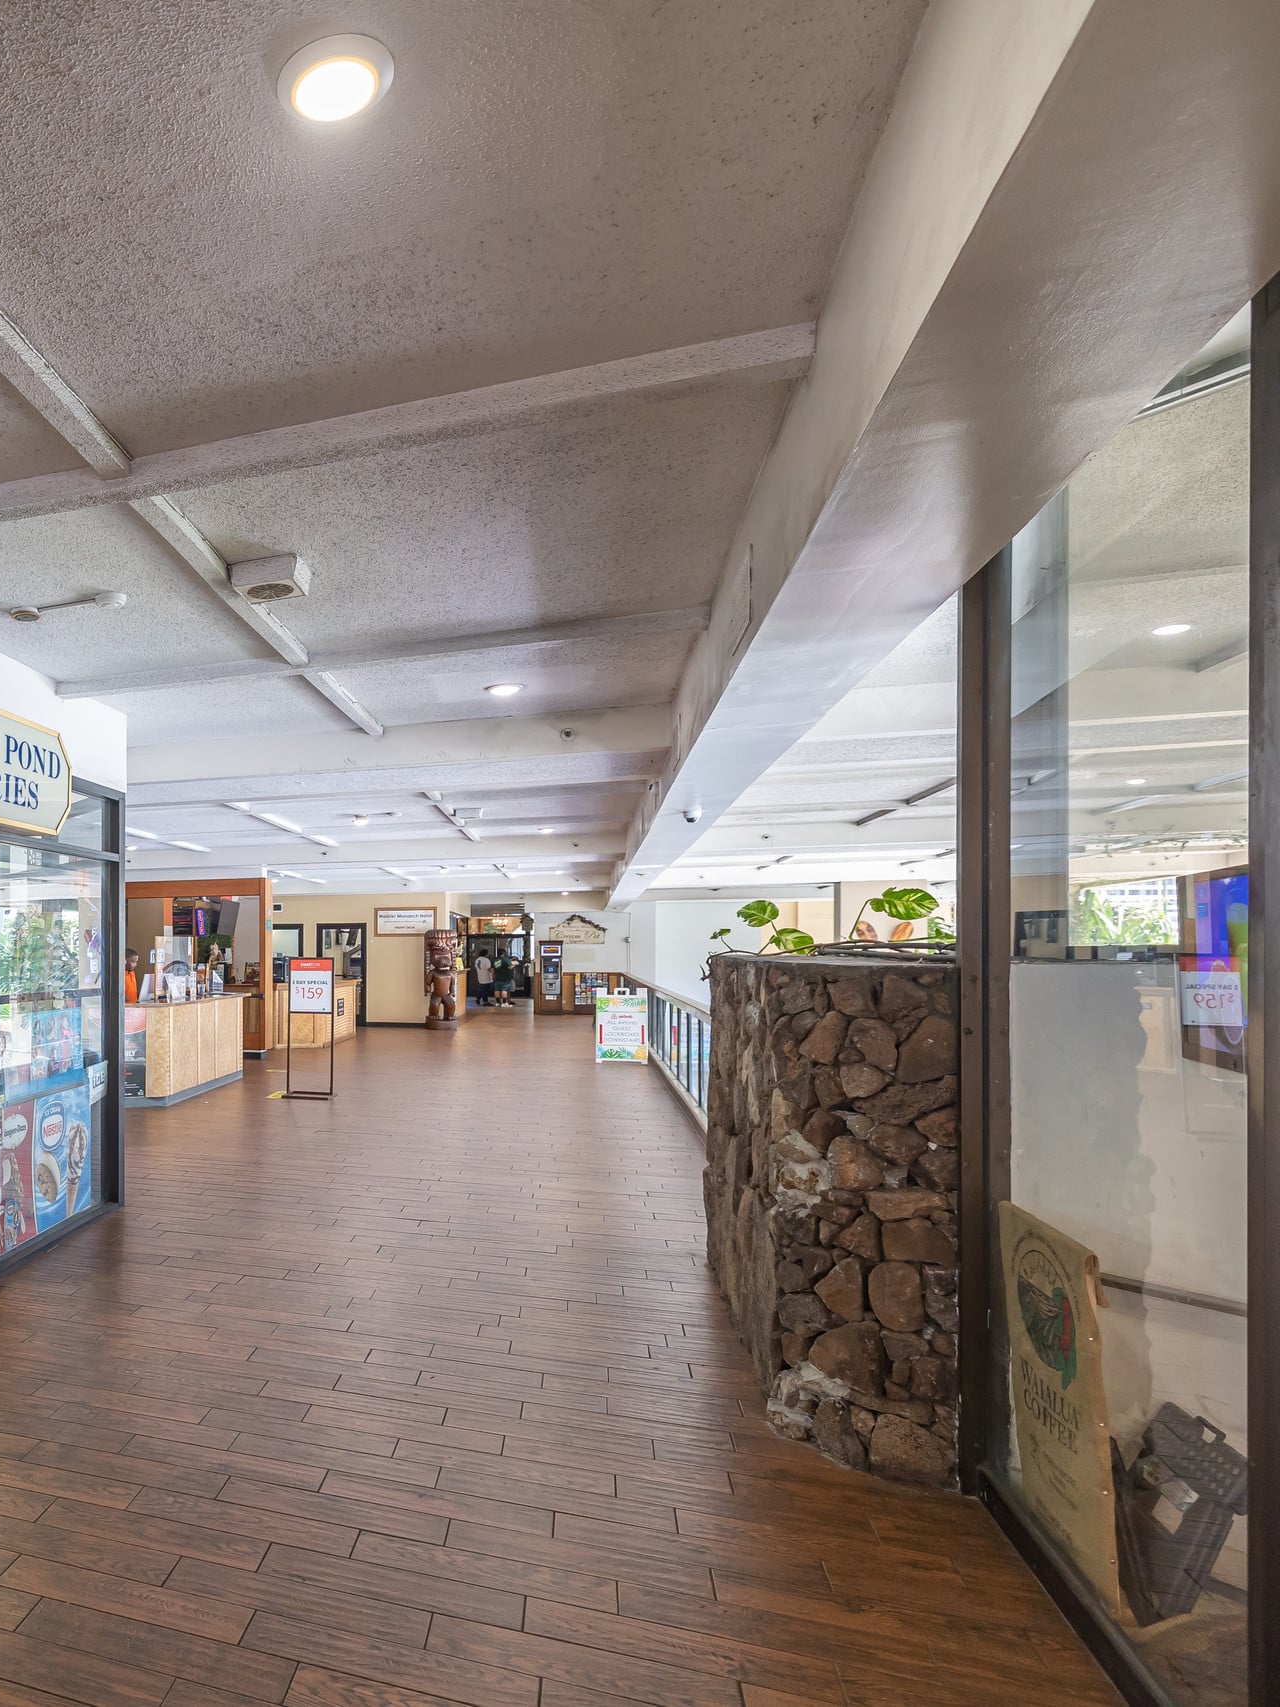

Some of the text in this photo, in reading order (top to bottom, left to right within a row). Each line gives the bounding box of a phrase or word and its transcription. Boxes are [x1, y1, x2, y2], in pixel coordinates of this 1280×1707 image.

[4, 734, 61, 780] POND
[295, 987, 323, 999] $159
[1021, 1355, 1080, 1432] WAIALUA
[1024, 1388, 1078, 1455] COFFEE
